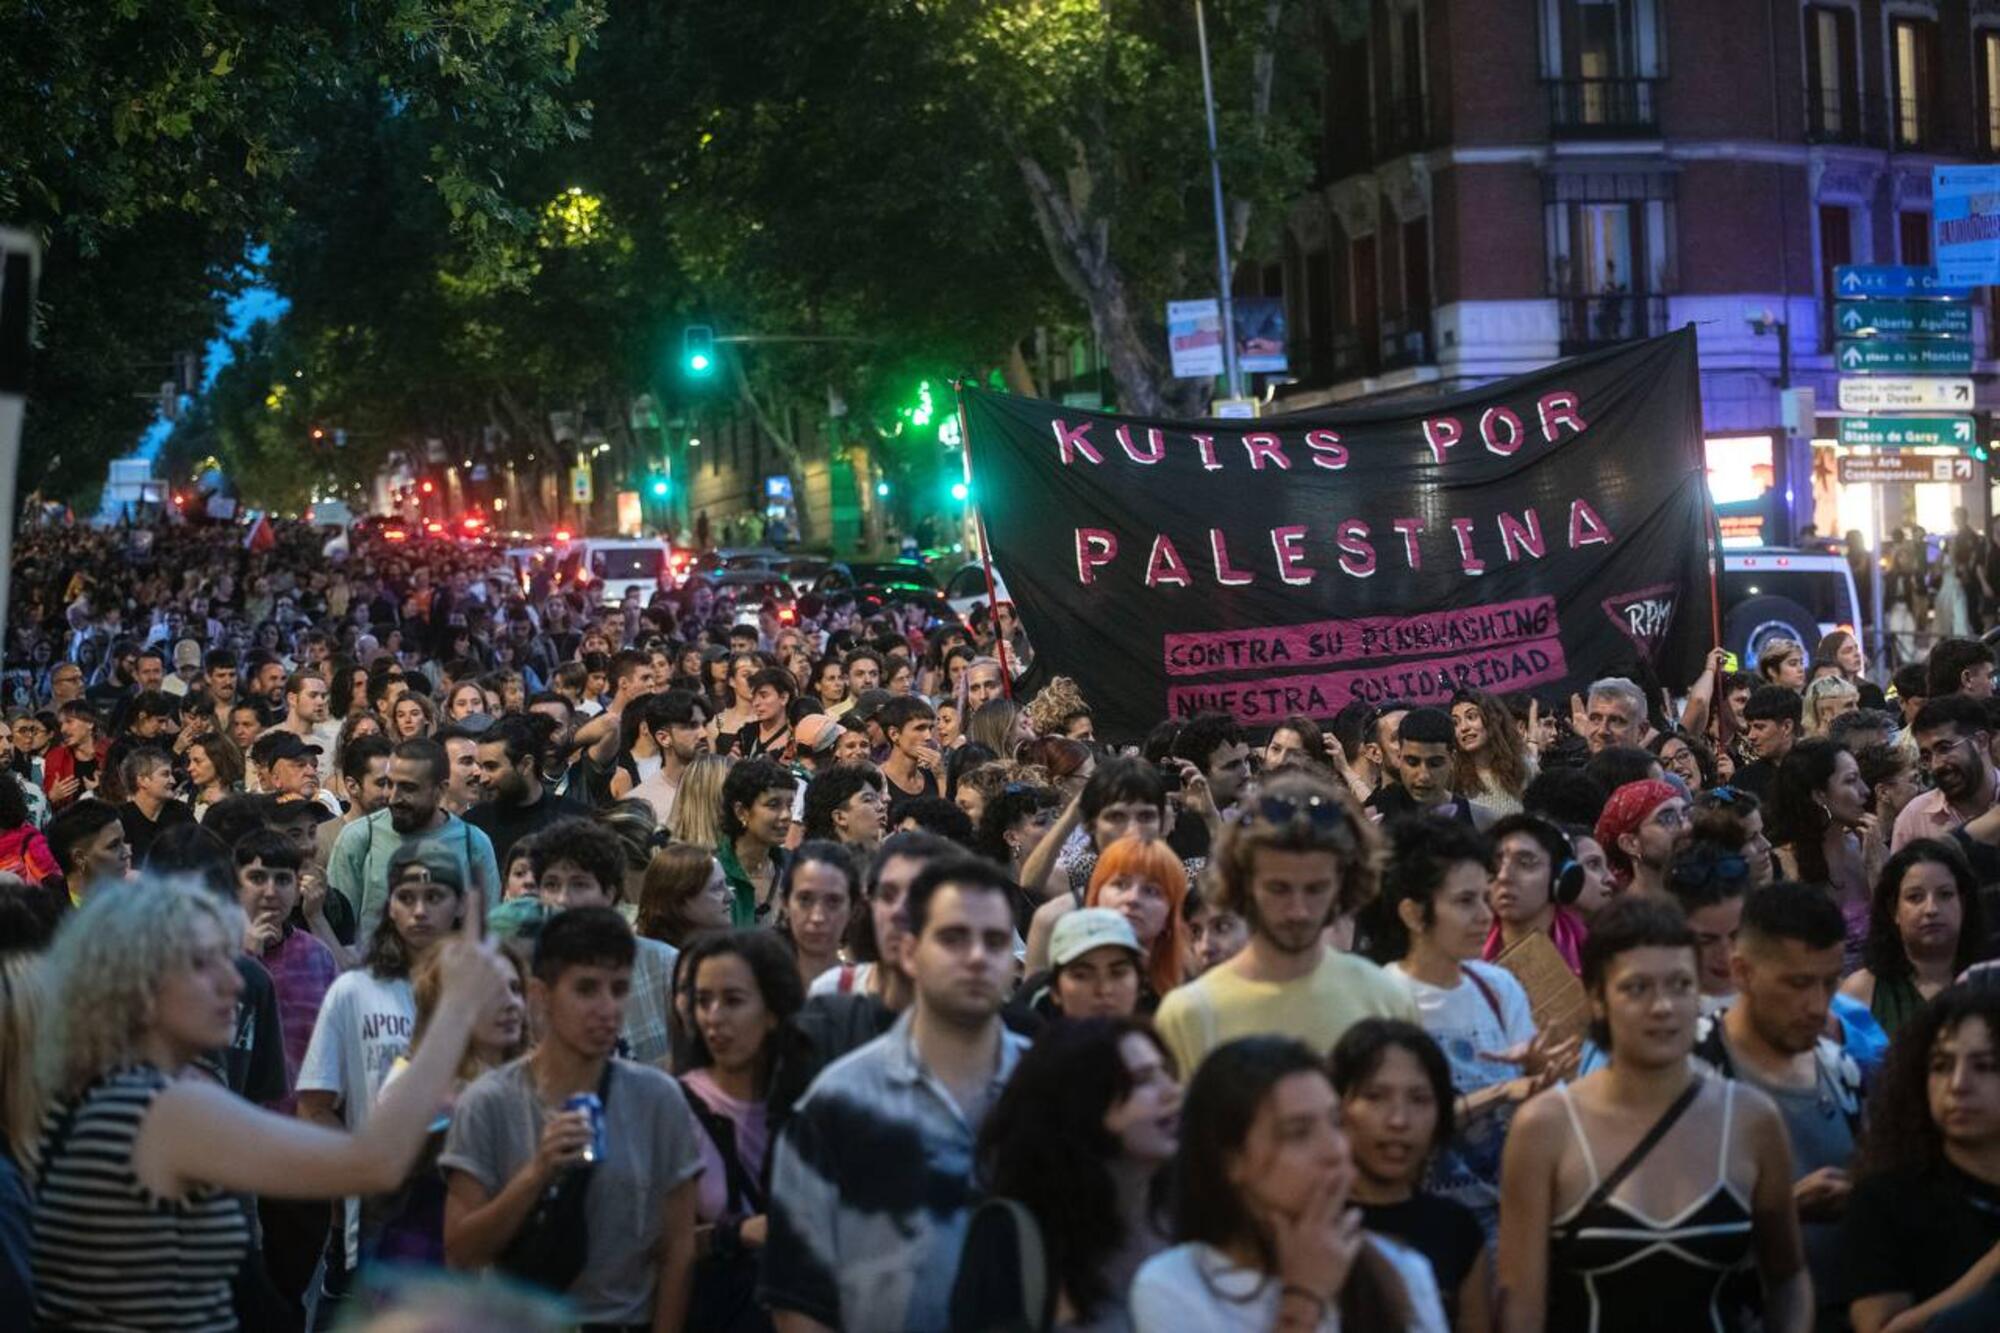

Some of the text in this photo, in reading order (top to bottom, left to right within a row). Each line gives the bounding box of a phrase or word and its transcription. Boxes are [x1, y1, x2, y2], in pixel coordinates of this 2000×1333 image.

[1872, 317, 1914, 328] Alberto
[1922, 350, 1969, 362] Moncloa
[1052, 391, 1588, 471] KUIRS POR
[1844, 432, 1883, 442] Blasco
[1075, 498, 1614, 588] PALESTINA
[1170, 602, 1551, 668] CONTRA SU PINKWASHING
[1624, 599, 1672, 637] RPM
[1350, 649, 1551, 702] SOLIDARIDAD
